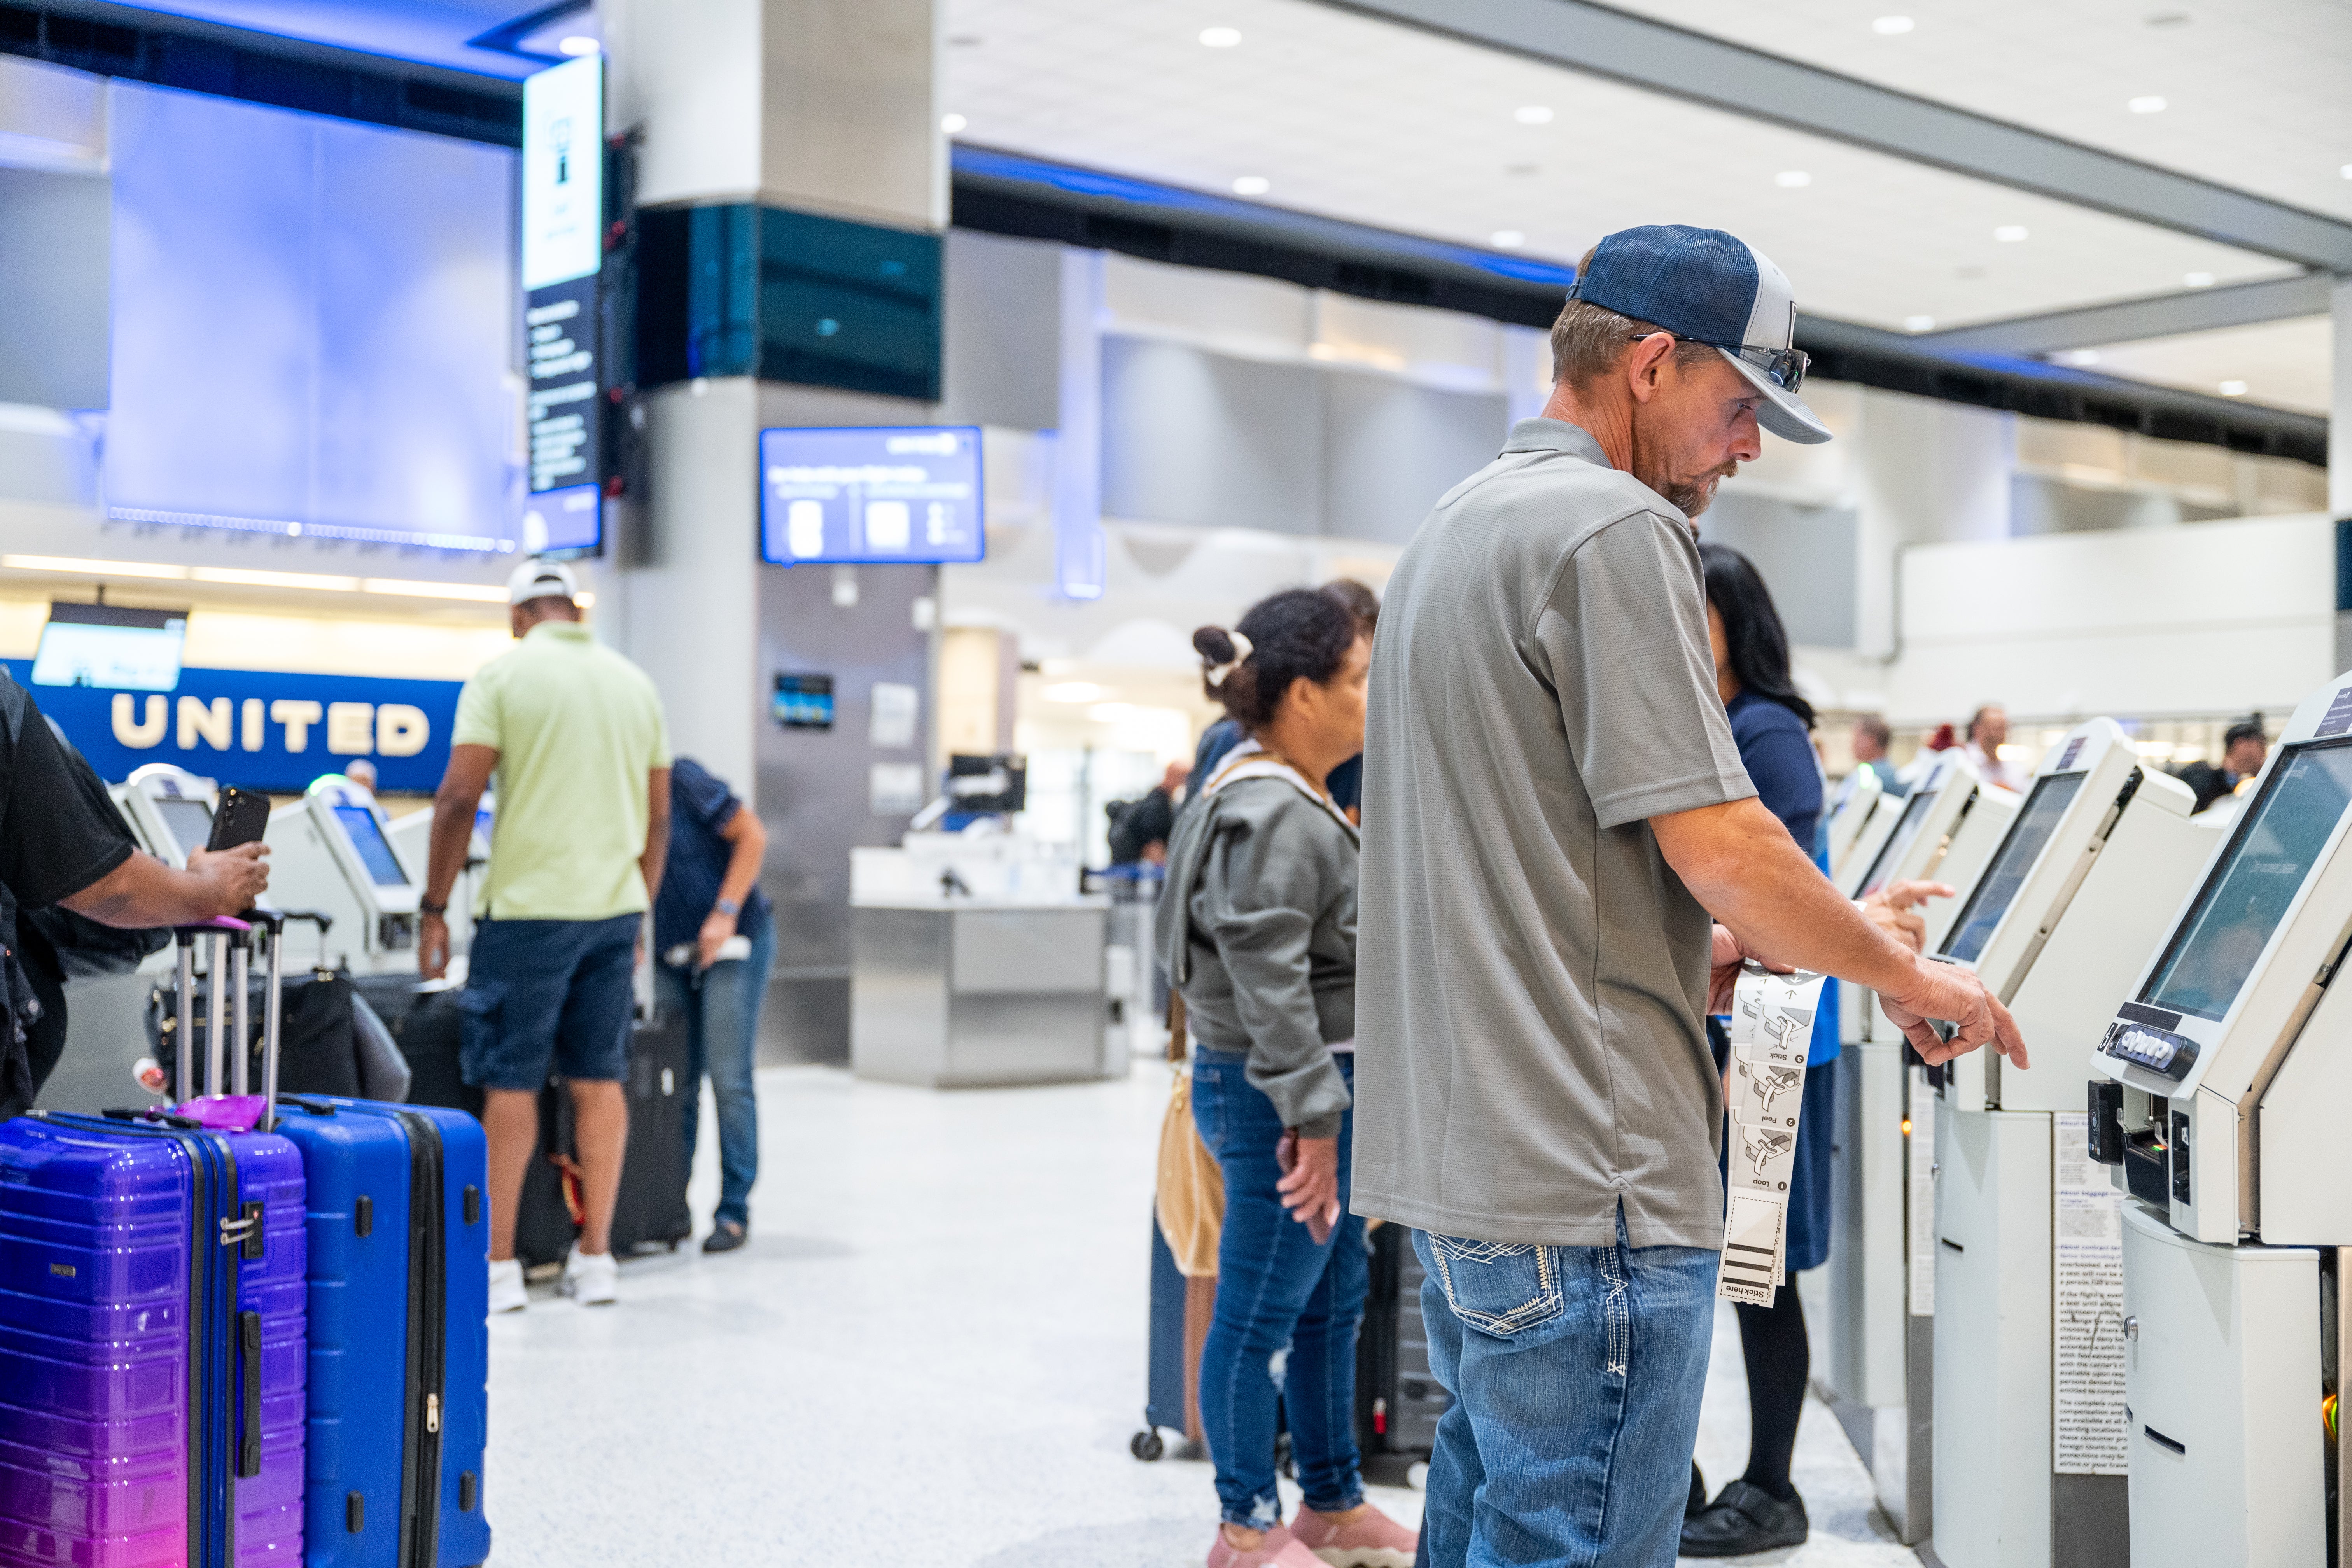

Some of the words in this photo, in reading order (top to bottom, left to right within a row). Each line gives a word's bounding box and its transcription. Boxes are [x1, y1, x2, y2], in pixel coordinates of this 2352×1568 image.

[111, 693, 430, 757] UNITED
[1770, 1052, 1787, 1060] Stick
[1753, 1179, 1769, 1187] Loop
[1726, 1286, 1743, 1295] here
[1745, 1288, 1764, 1298] Stick
